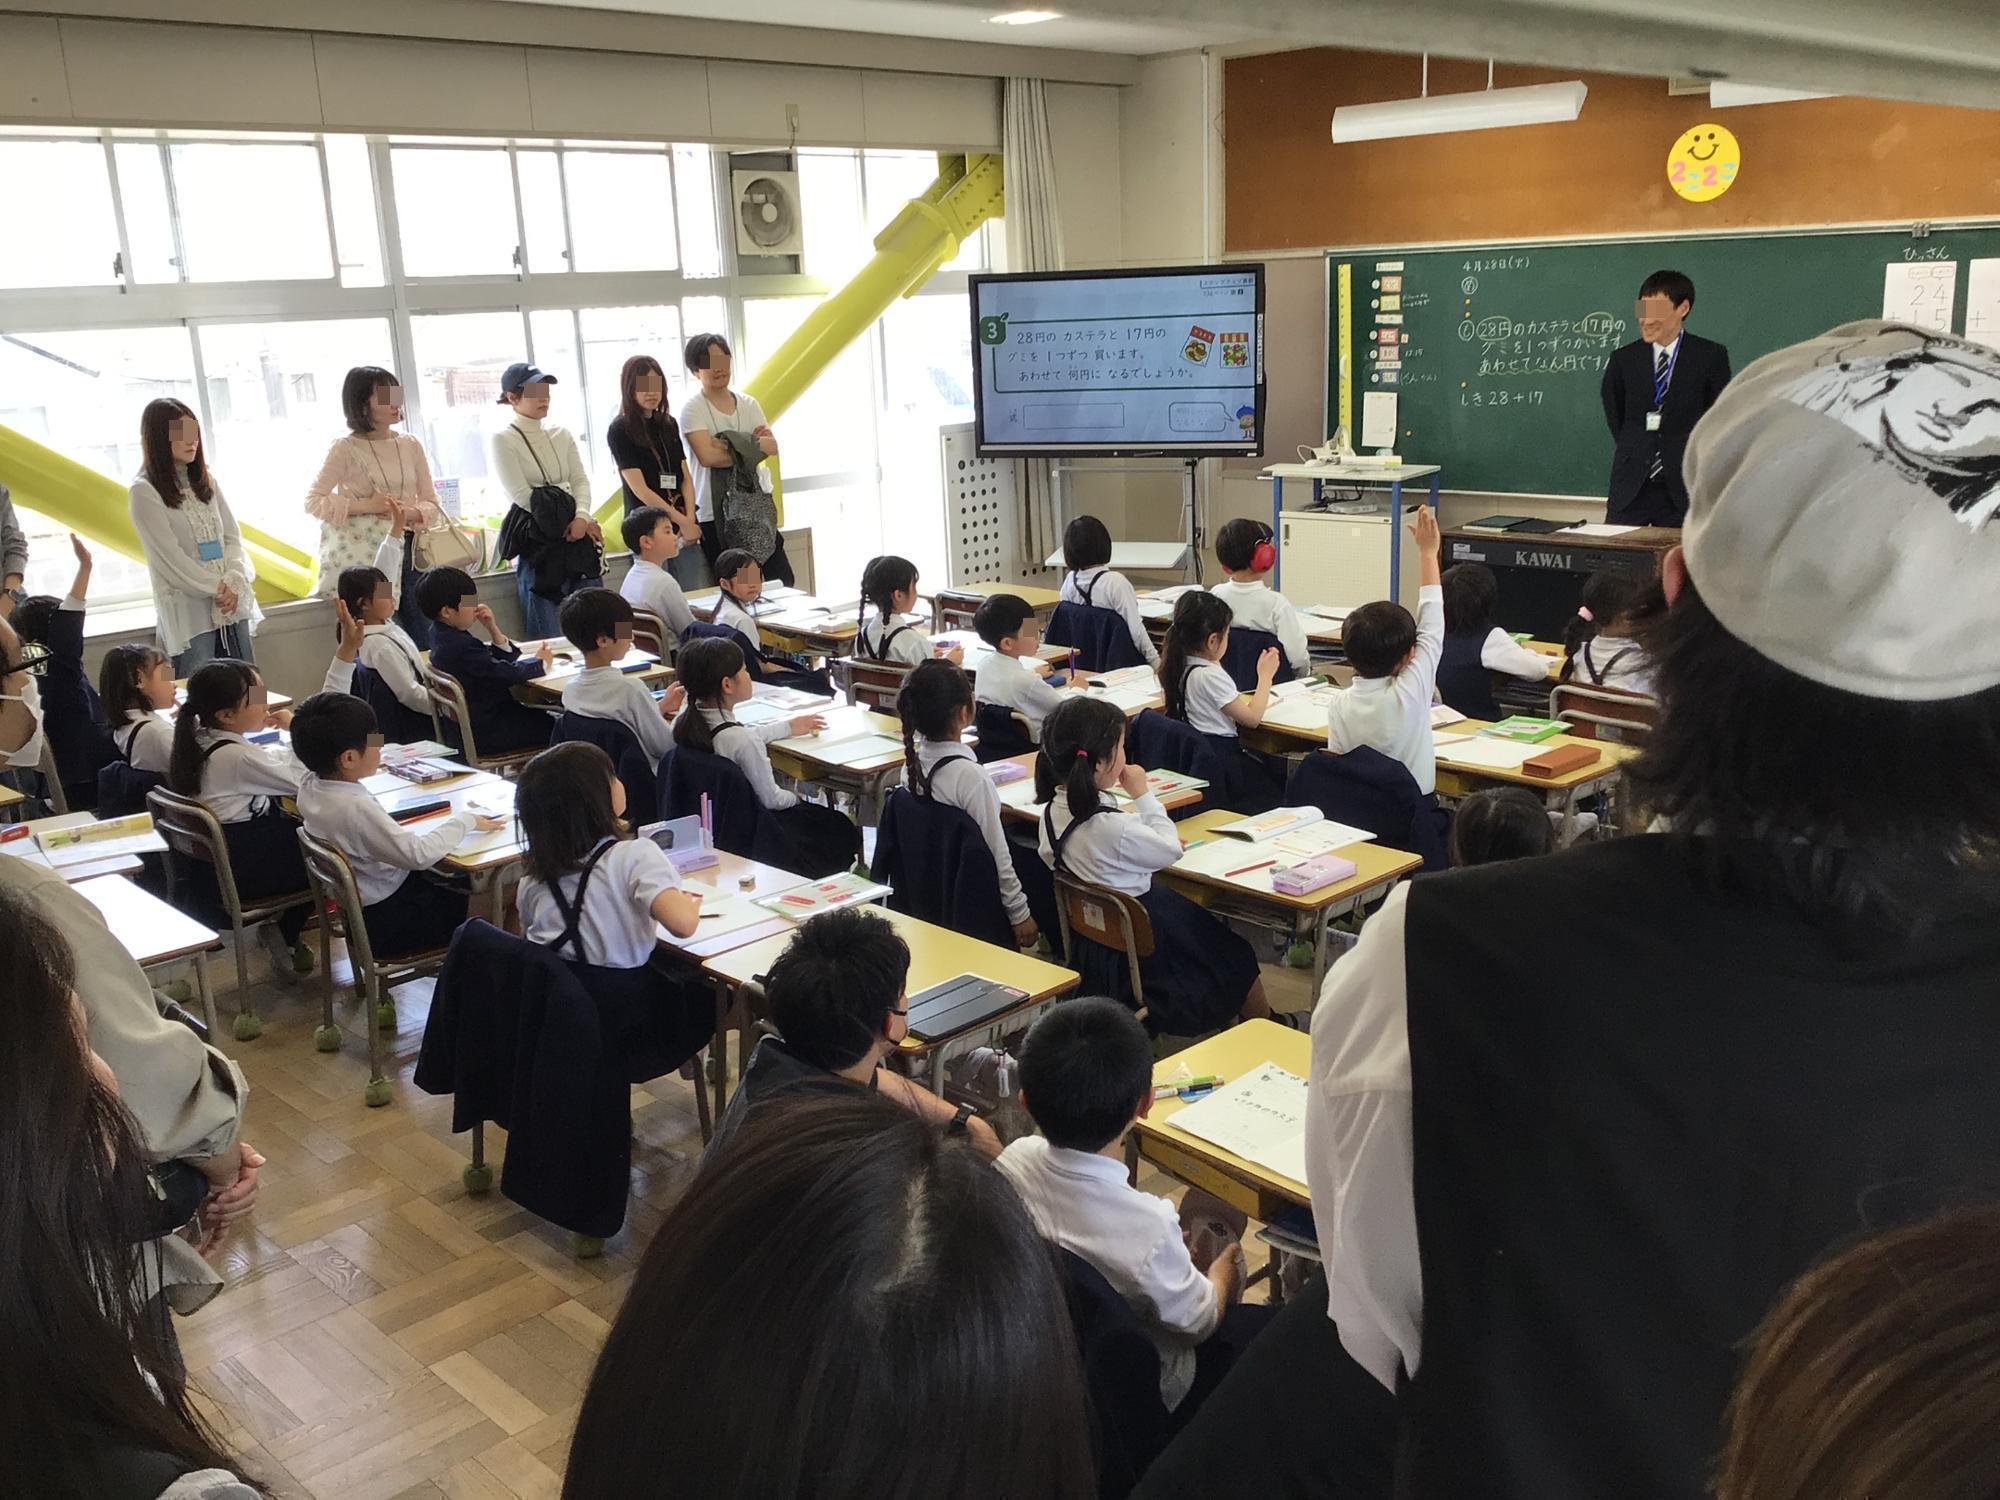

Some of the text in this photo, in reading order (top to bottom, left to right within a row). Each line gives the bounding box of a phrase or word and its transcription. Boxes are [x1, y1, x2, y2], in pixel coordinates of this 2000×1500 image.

[1903, 246, 1950, 260] ひっさん
[987, 322, 998, 340] 3
[1515, 551, 1571, 569] KAWAI
